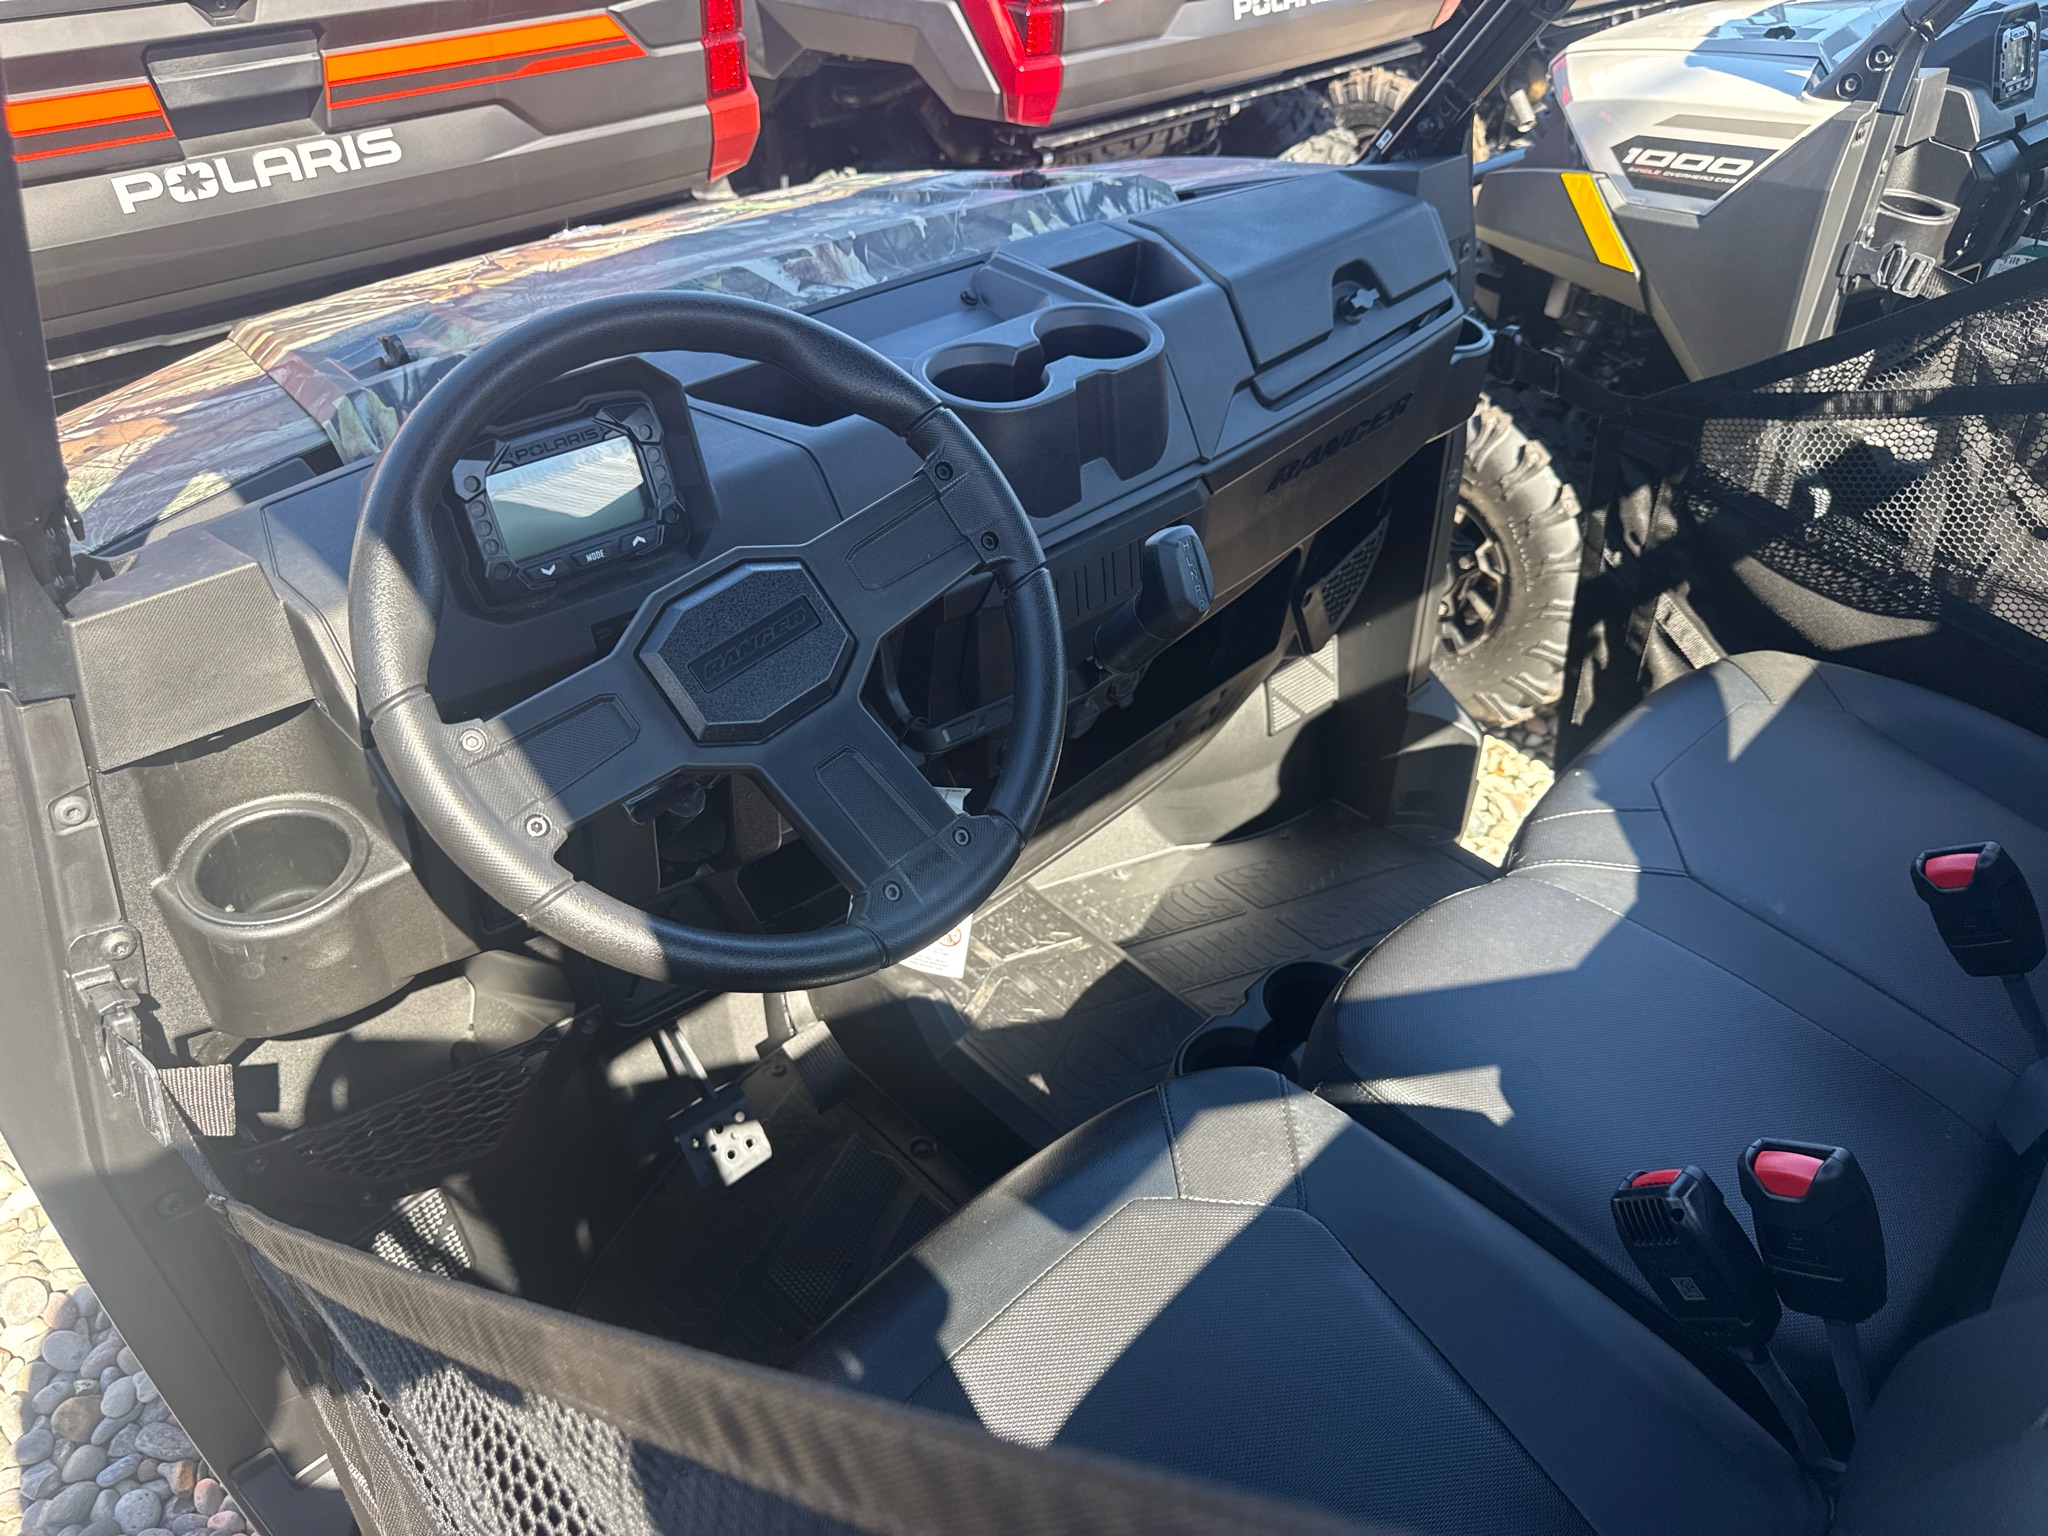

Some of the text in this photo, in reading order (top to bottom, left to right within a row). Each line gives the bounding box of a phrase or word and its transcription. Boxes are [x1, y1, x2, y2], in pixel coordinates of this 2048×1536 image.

[110, 128, 402, 215] POLARIS
[1622, 147, 1754, 176] 1000
[514, 428, 599, 460] POLARIS
[1264, 392, 1414, 495] RANGER
[586, 549, 605, 562] MODE
[704, 606, 806, 681] RANGER
